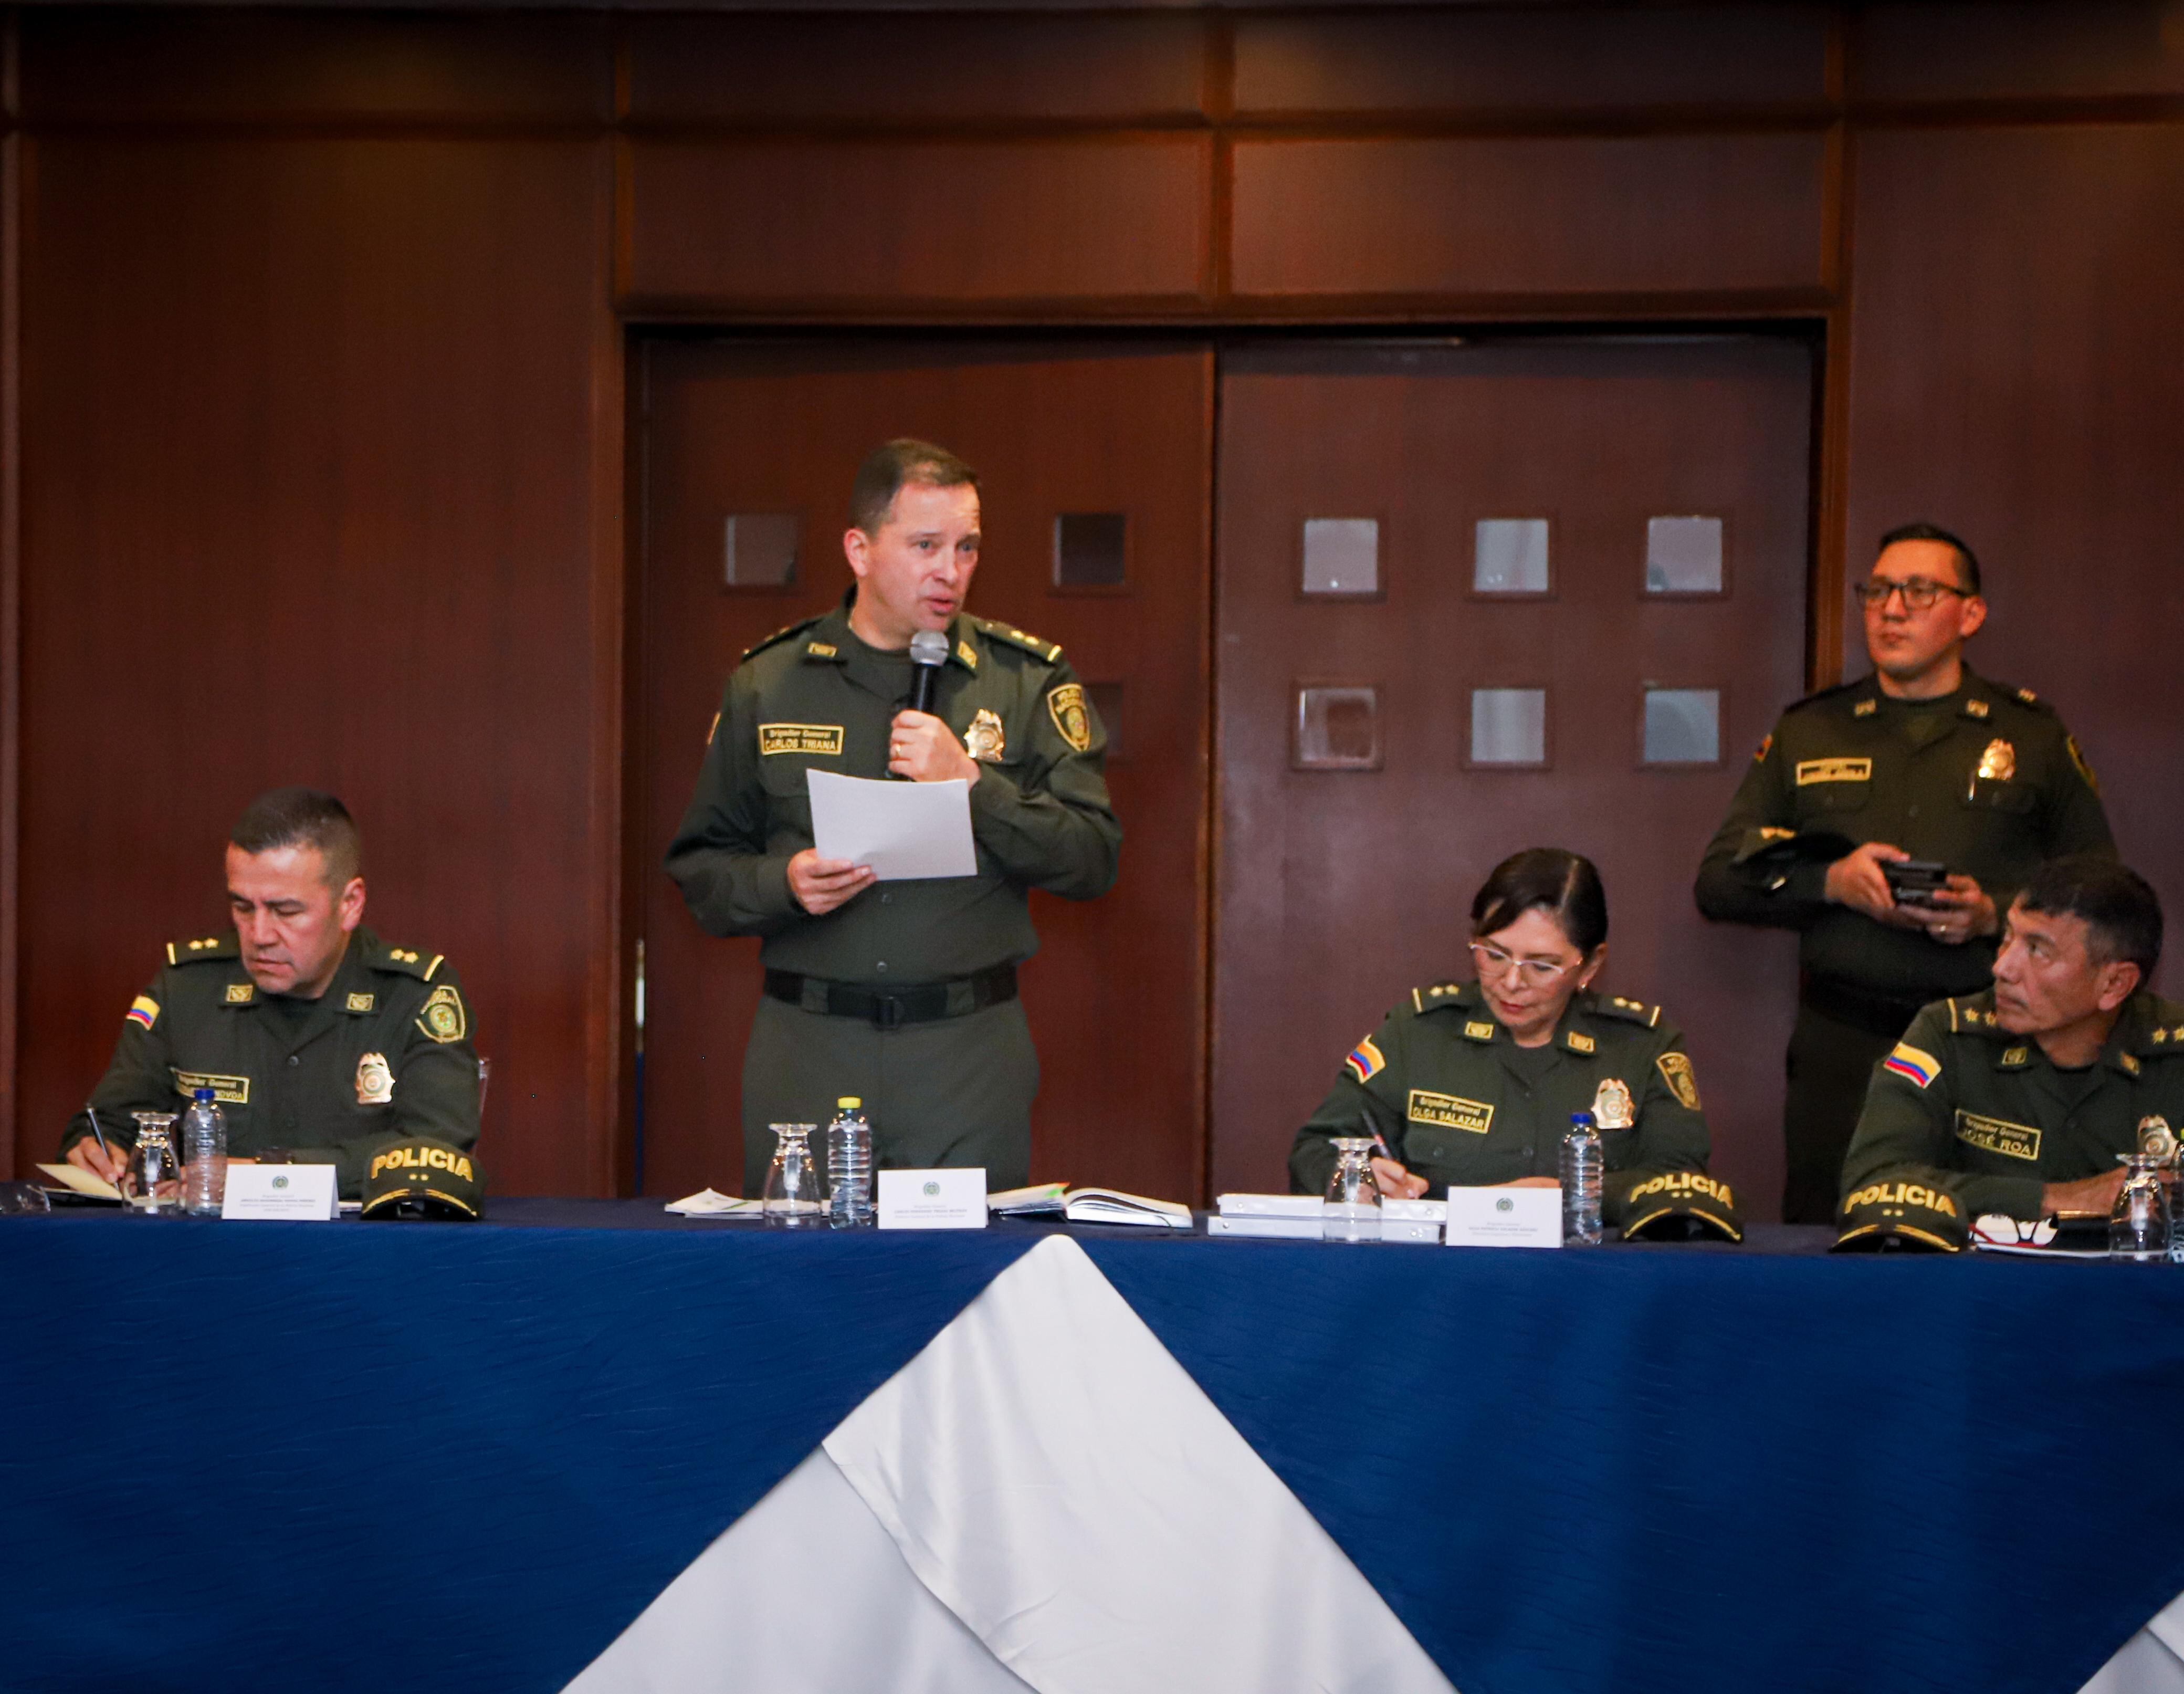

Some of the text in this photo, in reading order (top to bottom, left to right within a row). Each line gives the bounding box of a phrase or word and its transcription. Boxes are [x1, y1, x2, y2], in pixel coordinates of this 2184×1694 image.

[765, 738, 836, 750] CARLOS TRIANA
[1413, 1106, 1485, 1128] OLGA SALAZAR
[2000, 1139, 2031, 1156] ROA
[371, 1147, 473, 1183] POLICIA
[1630, 1172, 1733, 1210] POLICIA
[1844, 1183, 1957, 1218] POLICIA
